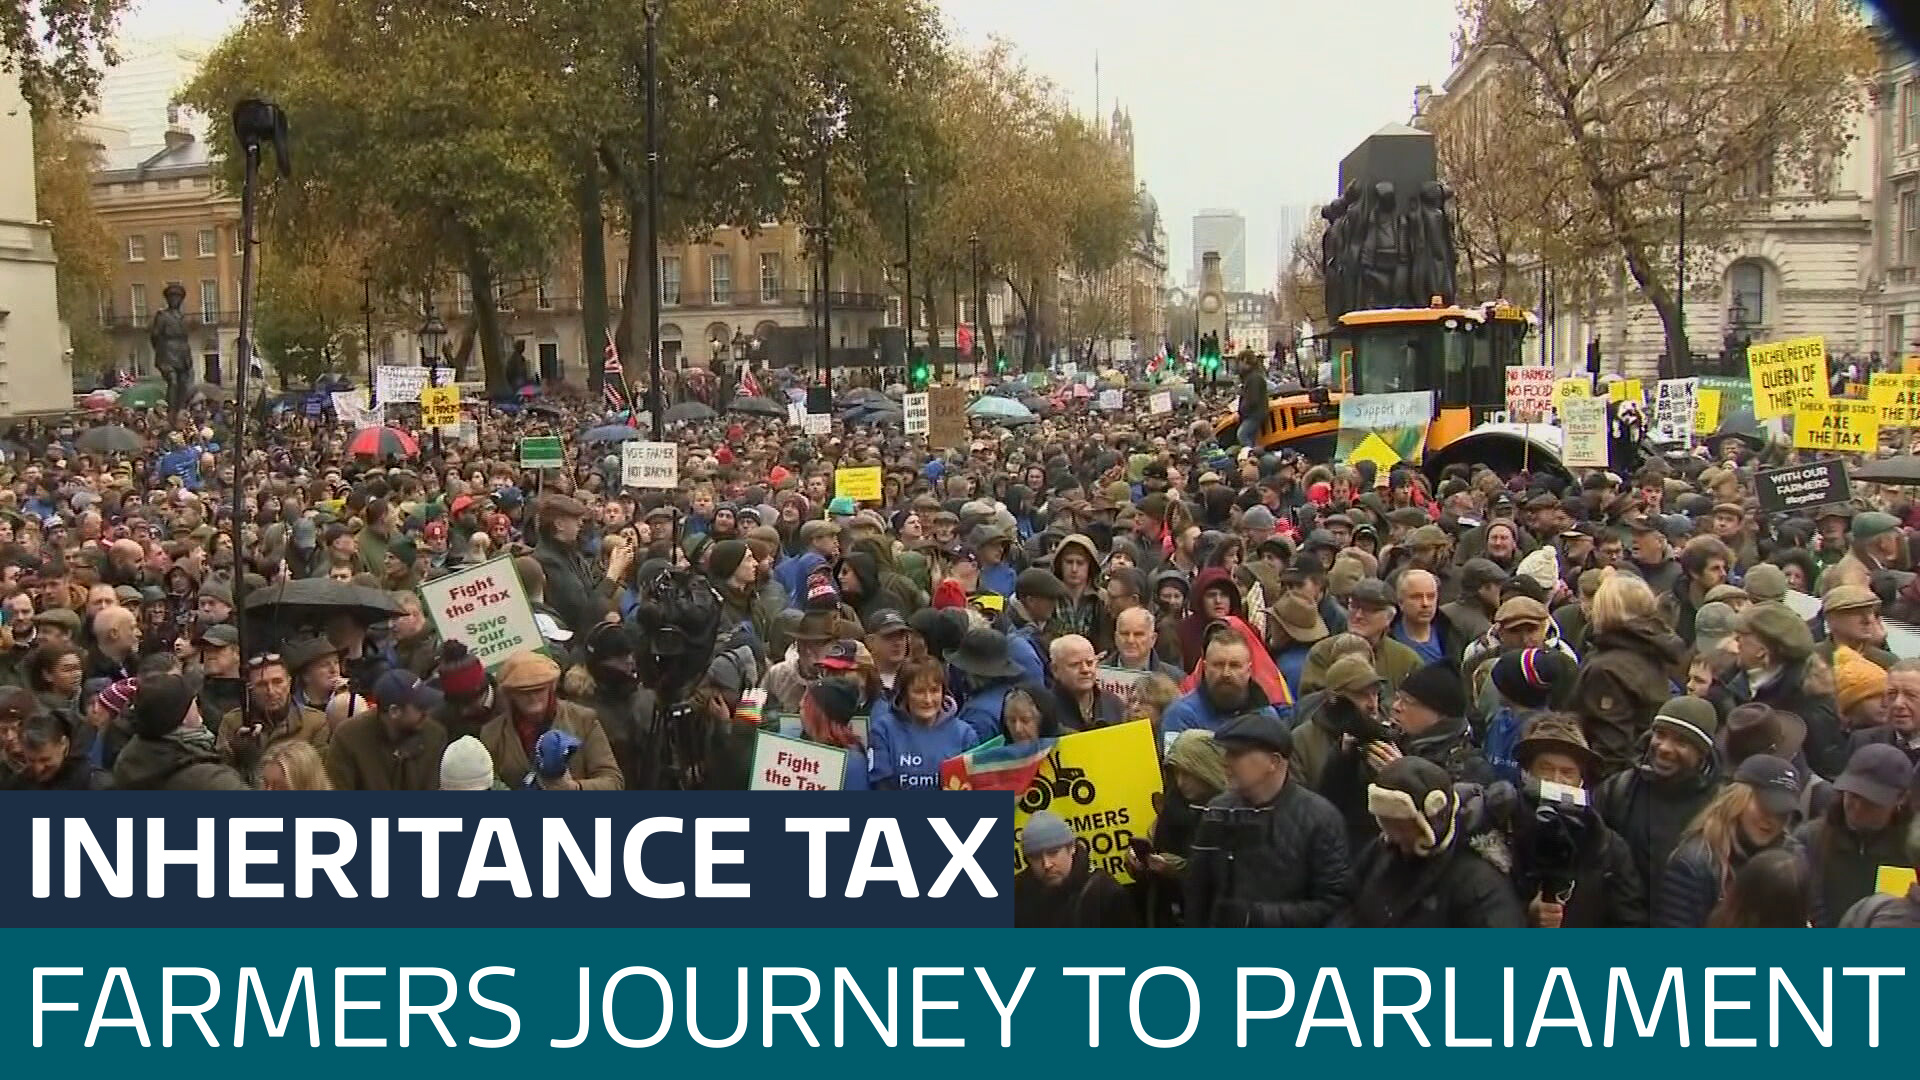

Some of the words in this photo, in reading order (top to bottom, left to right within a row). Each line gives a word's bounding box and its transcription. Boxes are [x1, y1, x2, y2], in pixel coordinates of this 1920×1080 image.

[1751, 349, 1785, 368] RACHEL
[1787, 343, 1821, 360] REEVES
[1761, 367, 1799, 389] QUEEN
[1801, 364, 1816, 382] OF
[1507, 384, 1521, 396] NO
[1523, 384, 1552, 397] FOOD
[1800, 402, 1824, 411] CHECK
[1827, 403, 1850, 413] YOUR
[1851, 404, 1876, 414] STATS
[1881, 407, 1904, 420] THE
[1823, 415, 1849, 429] AXE
[1808, 430, 1831, 444] THE
[1836, 431, 1861, 445] TAX
[1770, 471, 1802, 484] WITH
[1802, 467, 1829, 480] OUR
[1776, 478, 1831, 495] FARMERS
[448, 576, 495, 601] Fight
[445, 602, 475, 619] the
[476, 589, 511, 606] Tax
[465, 615, 508, 635] Save
[478, 628, 505, 645] our
[776, 751, 821, 775] Fight
[899, 754, 922, 766] No
[765, 768, 792, 788] the
[797, 775, 829, 790] Tax
[899, 773, 939, 787] Fami
